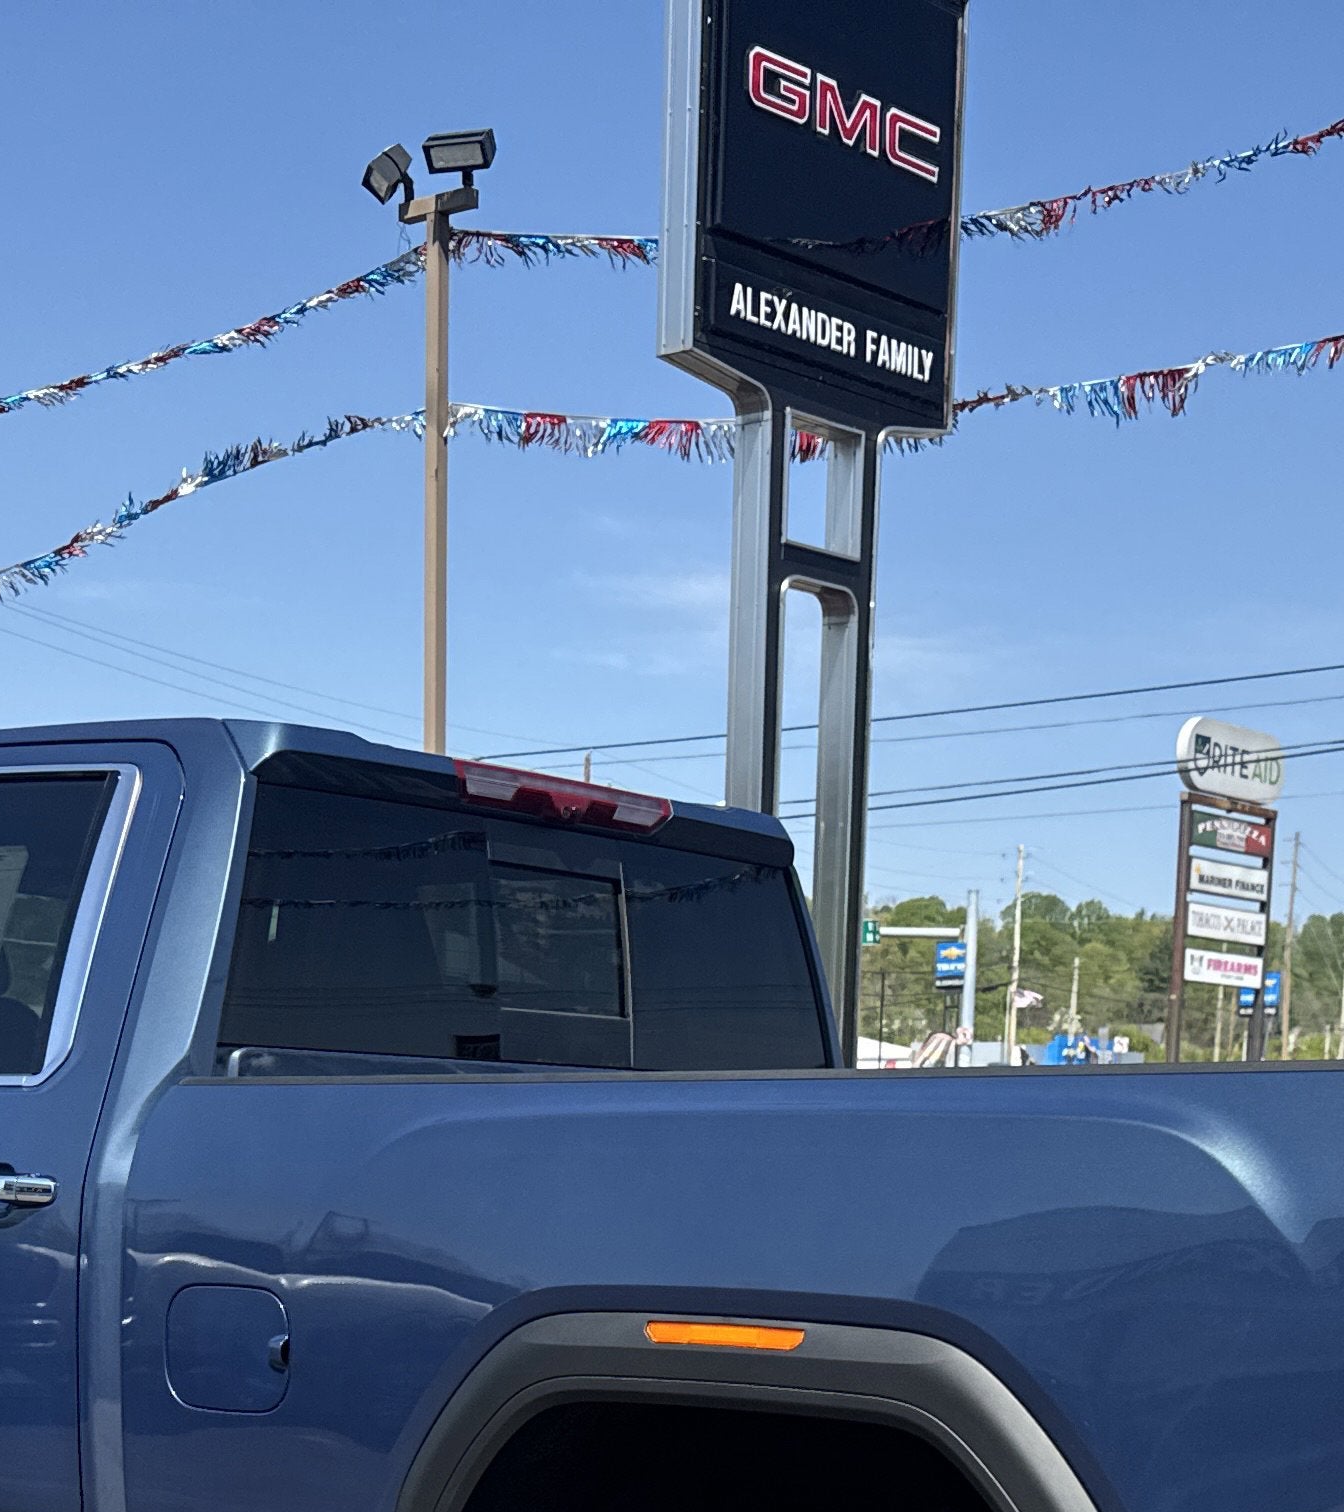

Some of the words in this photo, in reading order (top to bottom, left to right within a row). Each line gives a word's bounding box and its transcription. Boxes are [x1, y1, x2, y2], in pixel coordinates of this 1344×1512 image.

[749, 45, 940, 183] GMC
[729, 282, 856, 357] ALEXANDER
[865, 329, 934, 383] FAMILY
[1212, 741, 1250, 780] RITE
[1251, 755, 1282, 785] AID
[1198, 873, 1233, 889] MARINER
[1234, 878, 1265, 896] FINANCE
[1206, 957, 1258, 977] FIREARMS
